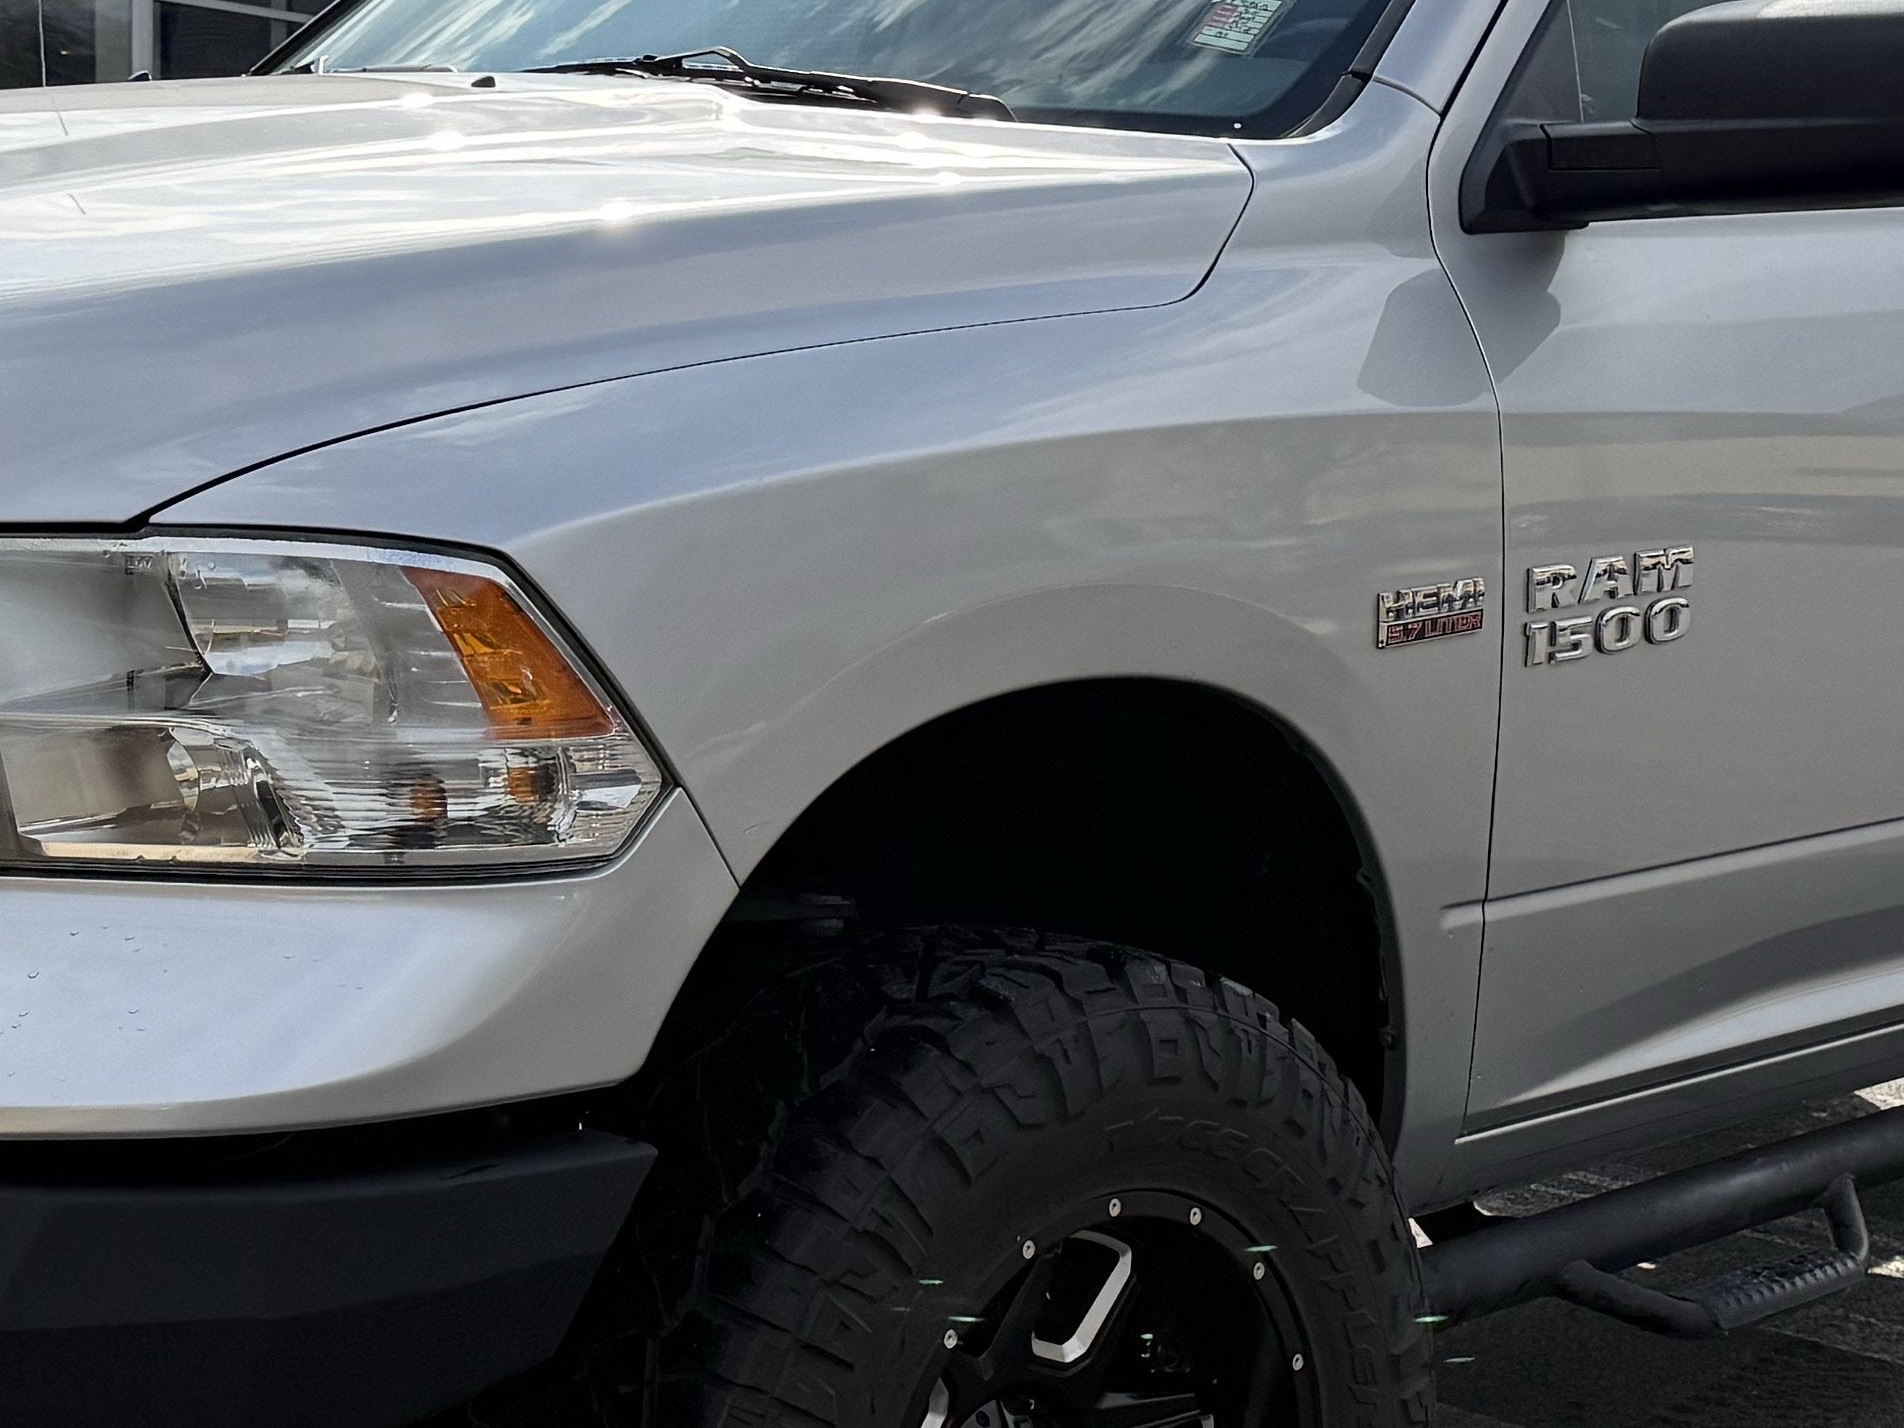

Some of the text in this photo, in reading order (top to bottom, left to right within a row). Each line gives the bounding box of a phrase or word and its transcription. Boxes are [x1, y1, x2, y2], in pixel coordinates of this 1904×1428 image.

[1377, 577, 1485, 622] HEMI
[1526, 545, 1694, 613] RAM
[1524, 596, 1690, 668] 1500
